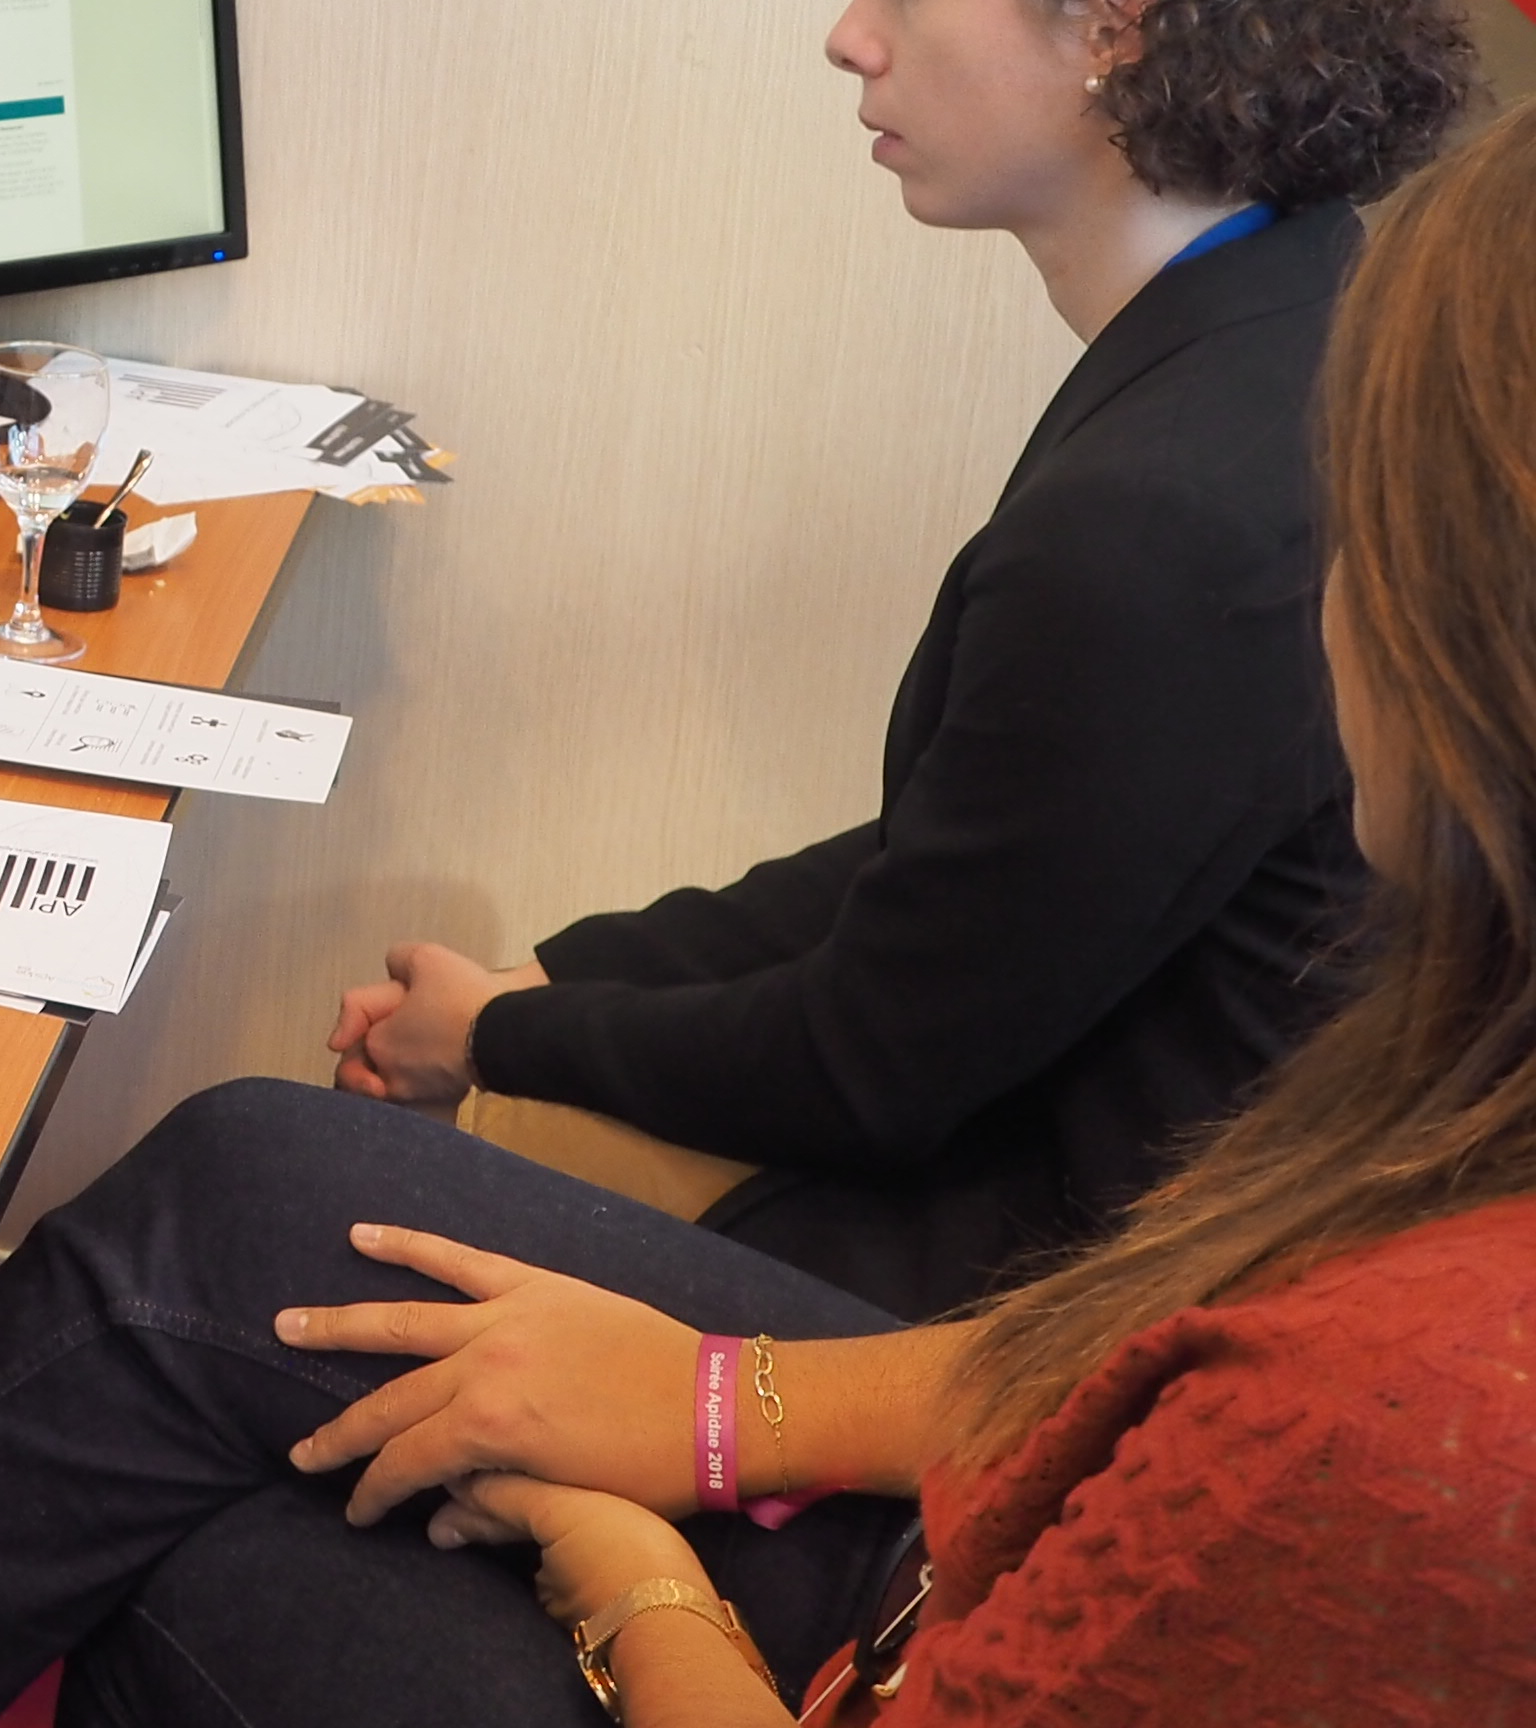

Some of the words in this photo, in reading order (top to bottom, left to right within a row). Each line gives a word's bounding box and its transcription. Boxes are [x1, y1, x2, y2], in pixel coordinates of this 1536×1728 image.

[29, 896, 84, 917] API
[708, 1351, 725, 1390] Soirée
[705, 1392, 723, 1448] Apidae
[708, 1451, 724, 1489] 2018
